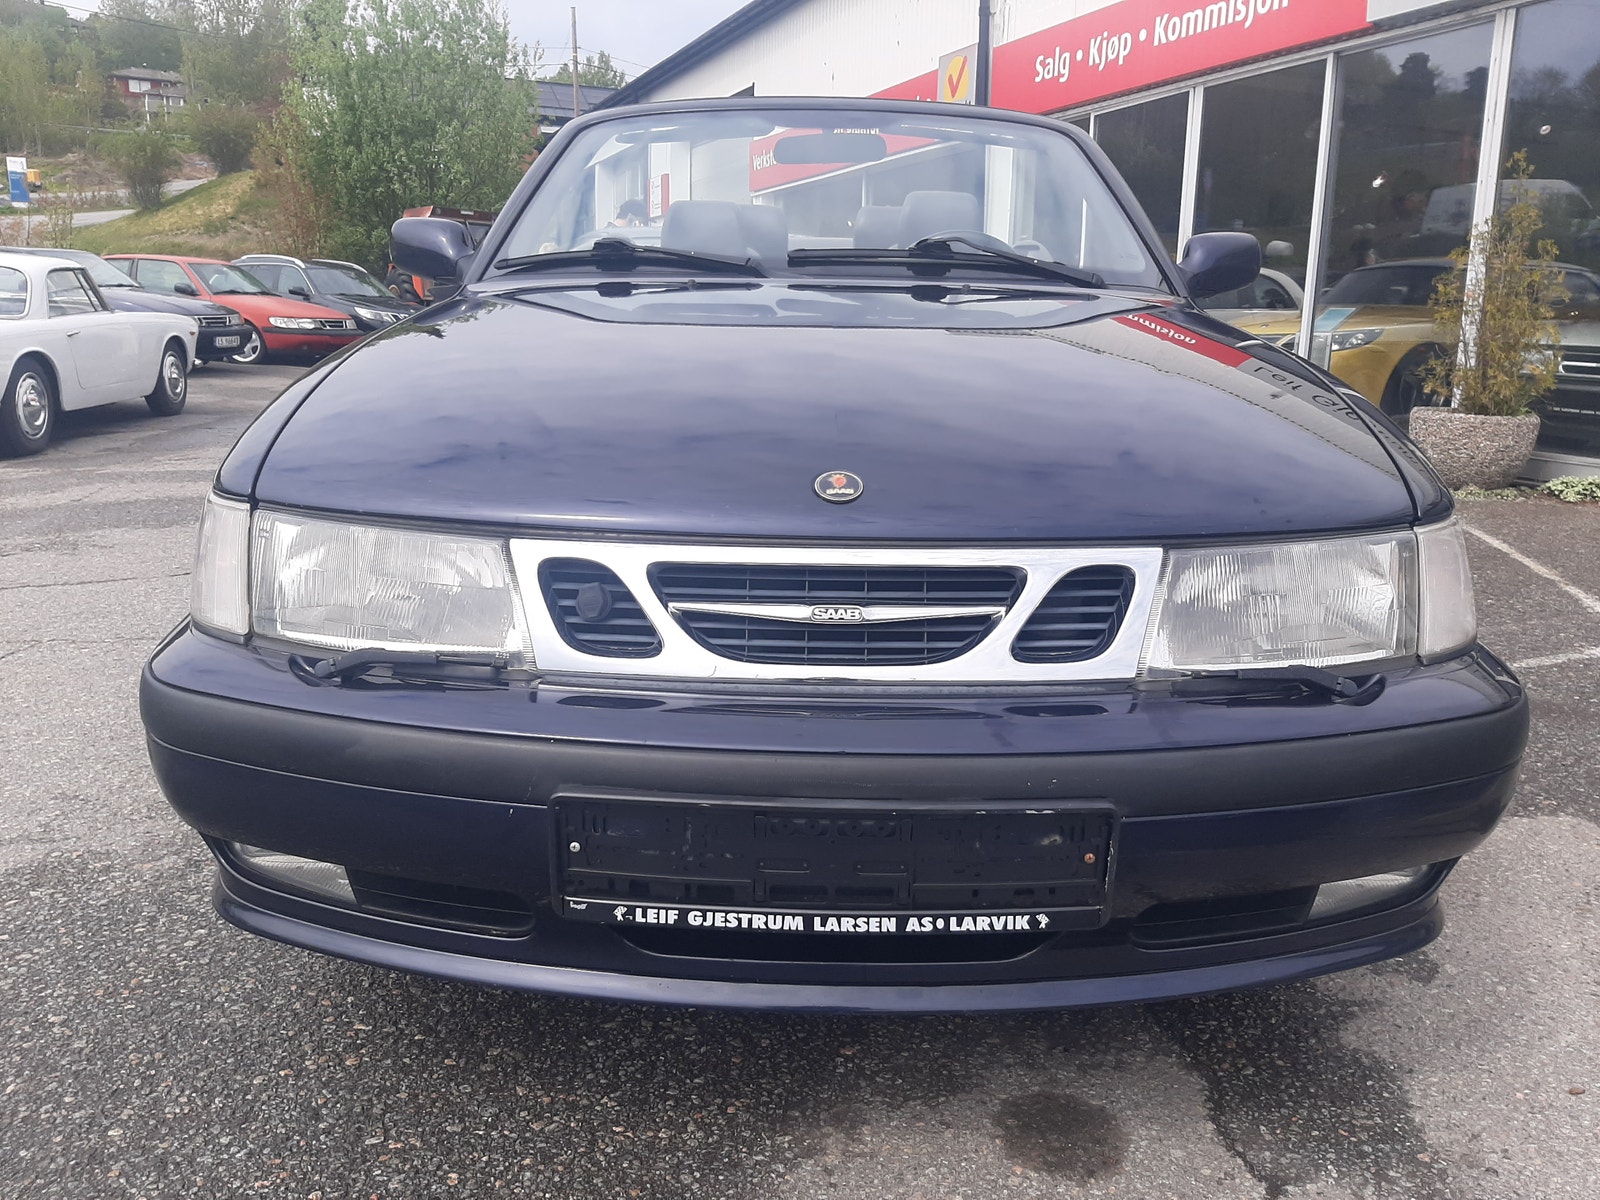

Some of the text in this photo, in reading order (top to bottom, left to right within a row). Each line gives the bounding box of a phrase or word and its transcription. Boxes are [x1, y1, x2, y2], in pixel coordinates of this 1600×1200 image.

[1034, 46, 1071, 83] Salg
[1087, 31, 1132, 71] Kjøp
[813, 607, 862, 620] SAAB
[634, 907, 679, 925] LEIF
[687, 911, 804, 931] GJESTRUM
[813, 916, 897, 932] LARSEN
[949, 914, 1031, 932] LARVIK
